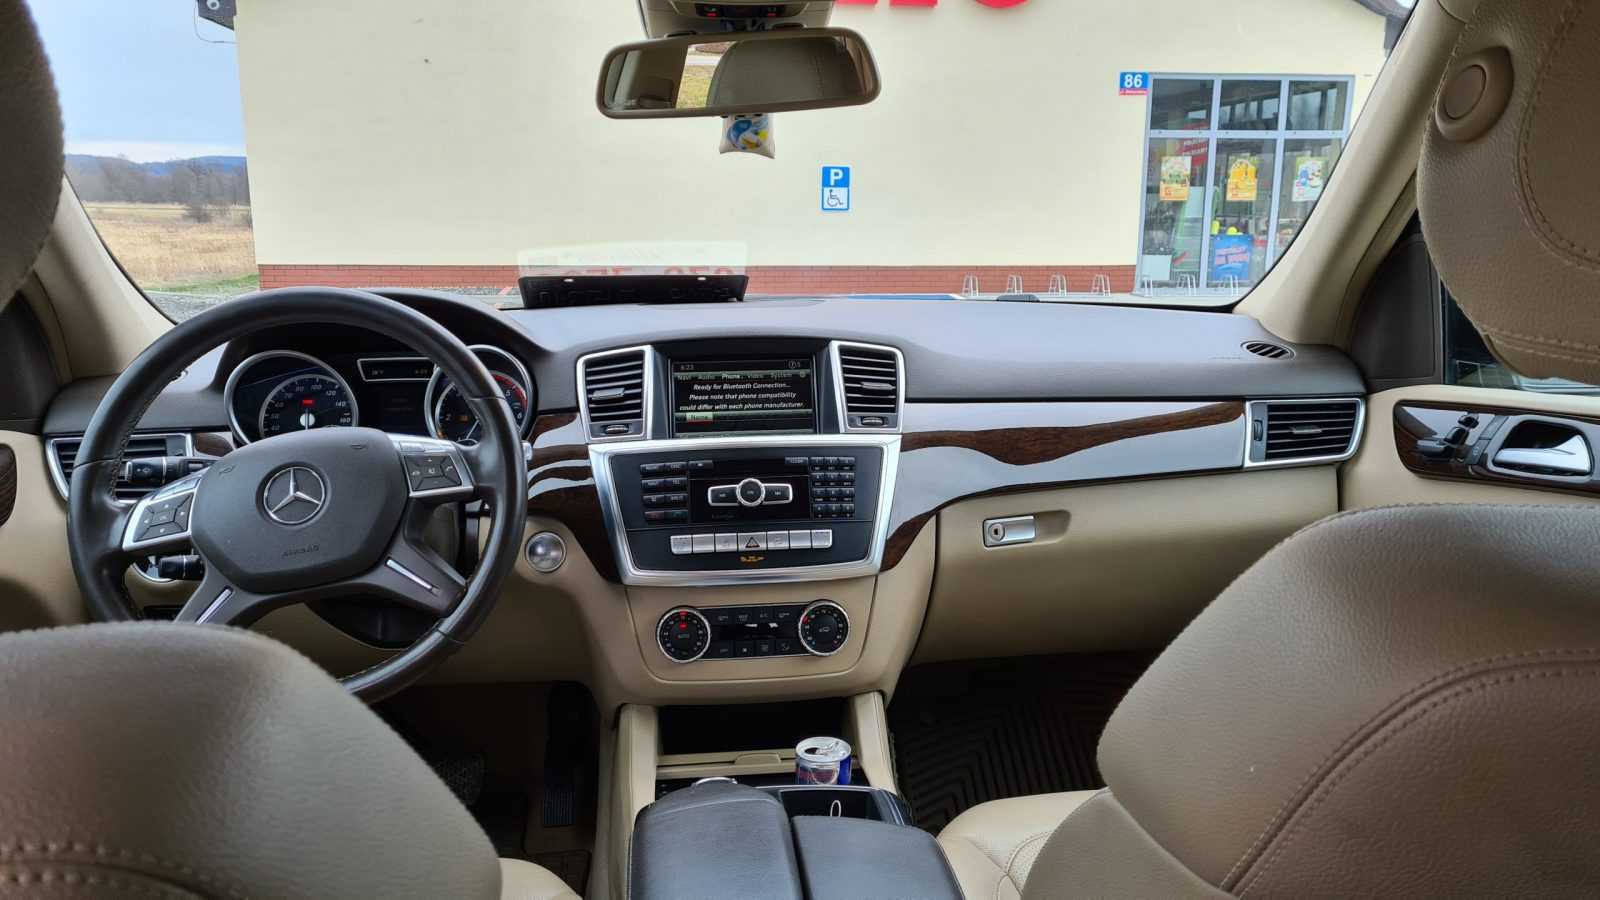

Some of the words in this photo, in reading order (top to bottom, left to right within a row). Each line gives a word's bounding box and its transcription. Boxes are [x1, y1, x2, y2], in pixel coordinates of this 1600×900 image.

[1124, 73, 1143, 88] 86
[828, 168, 844, 186] P
[744, 402, 763, 410] phone
